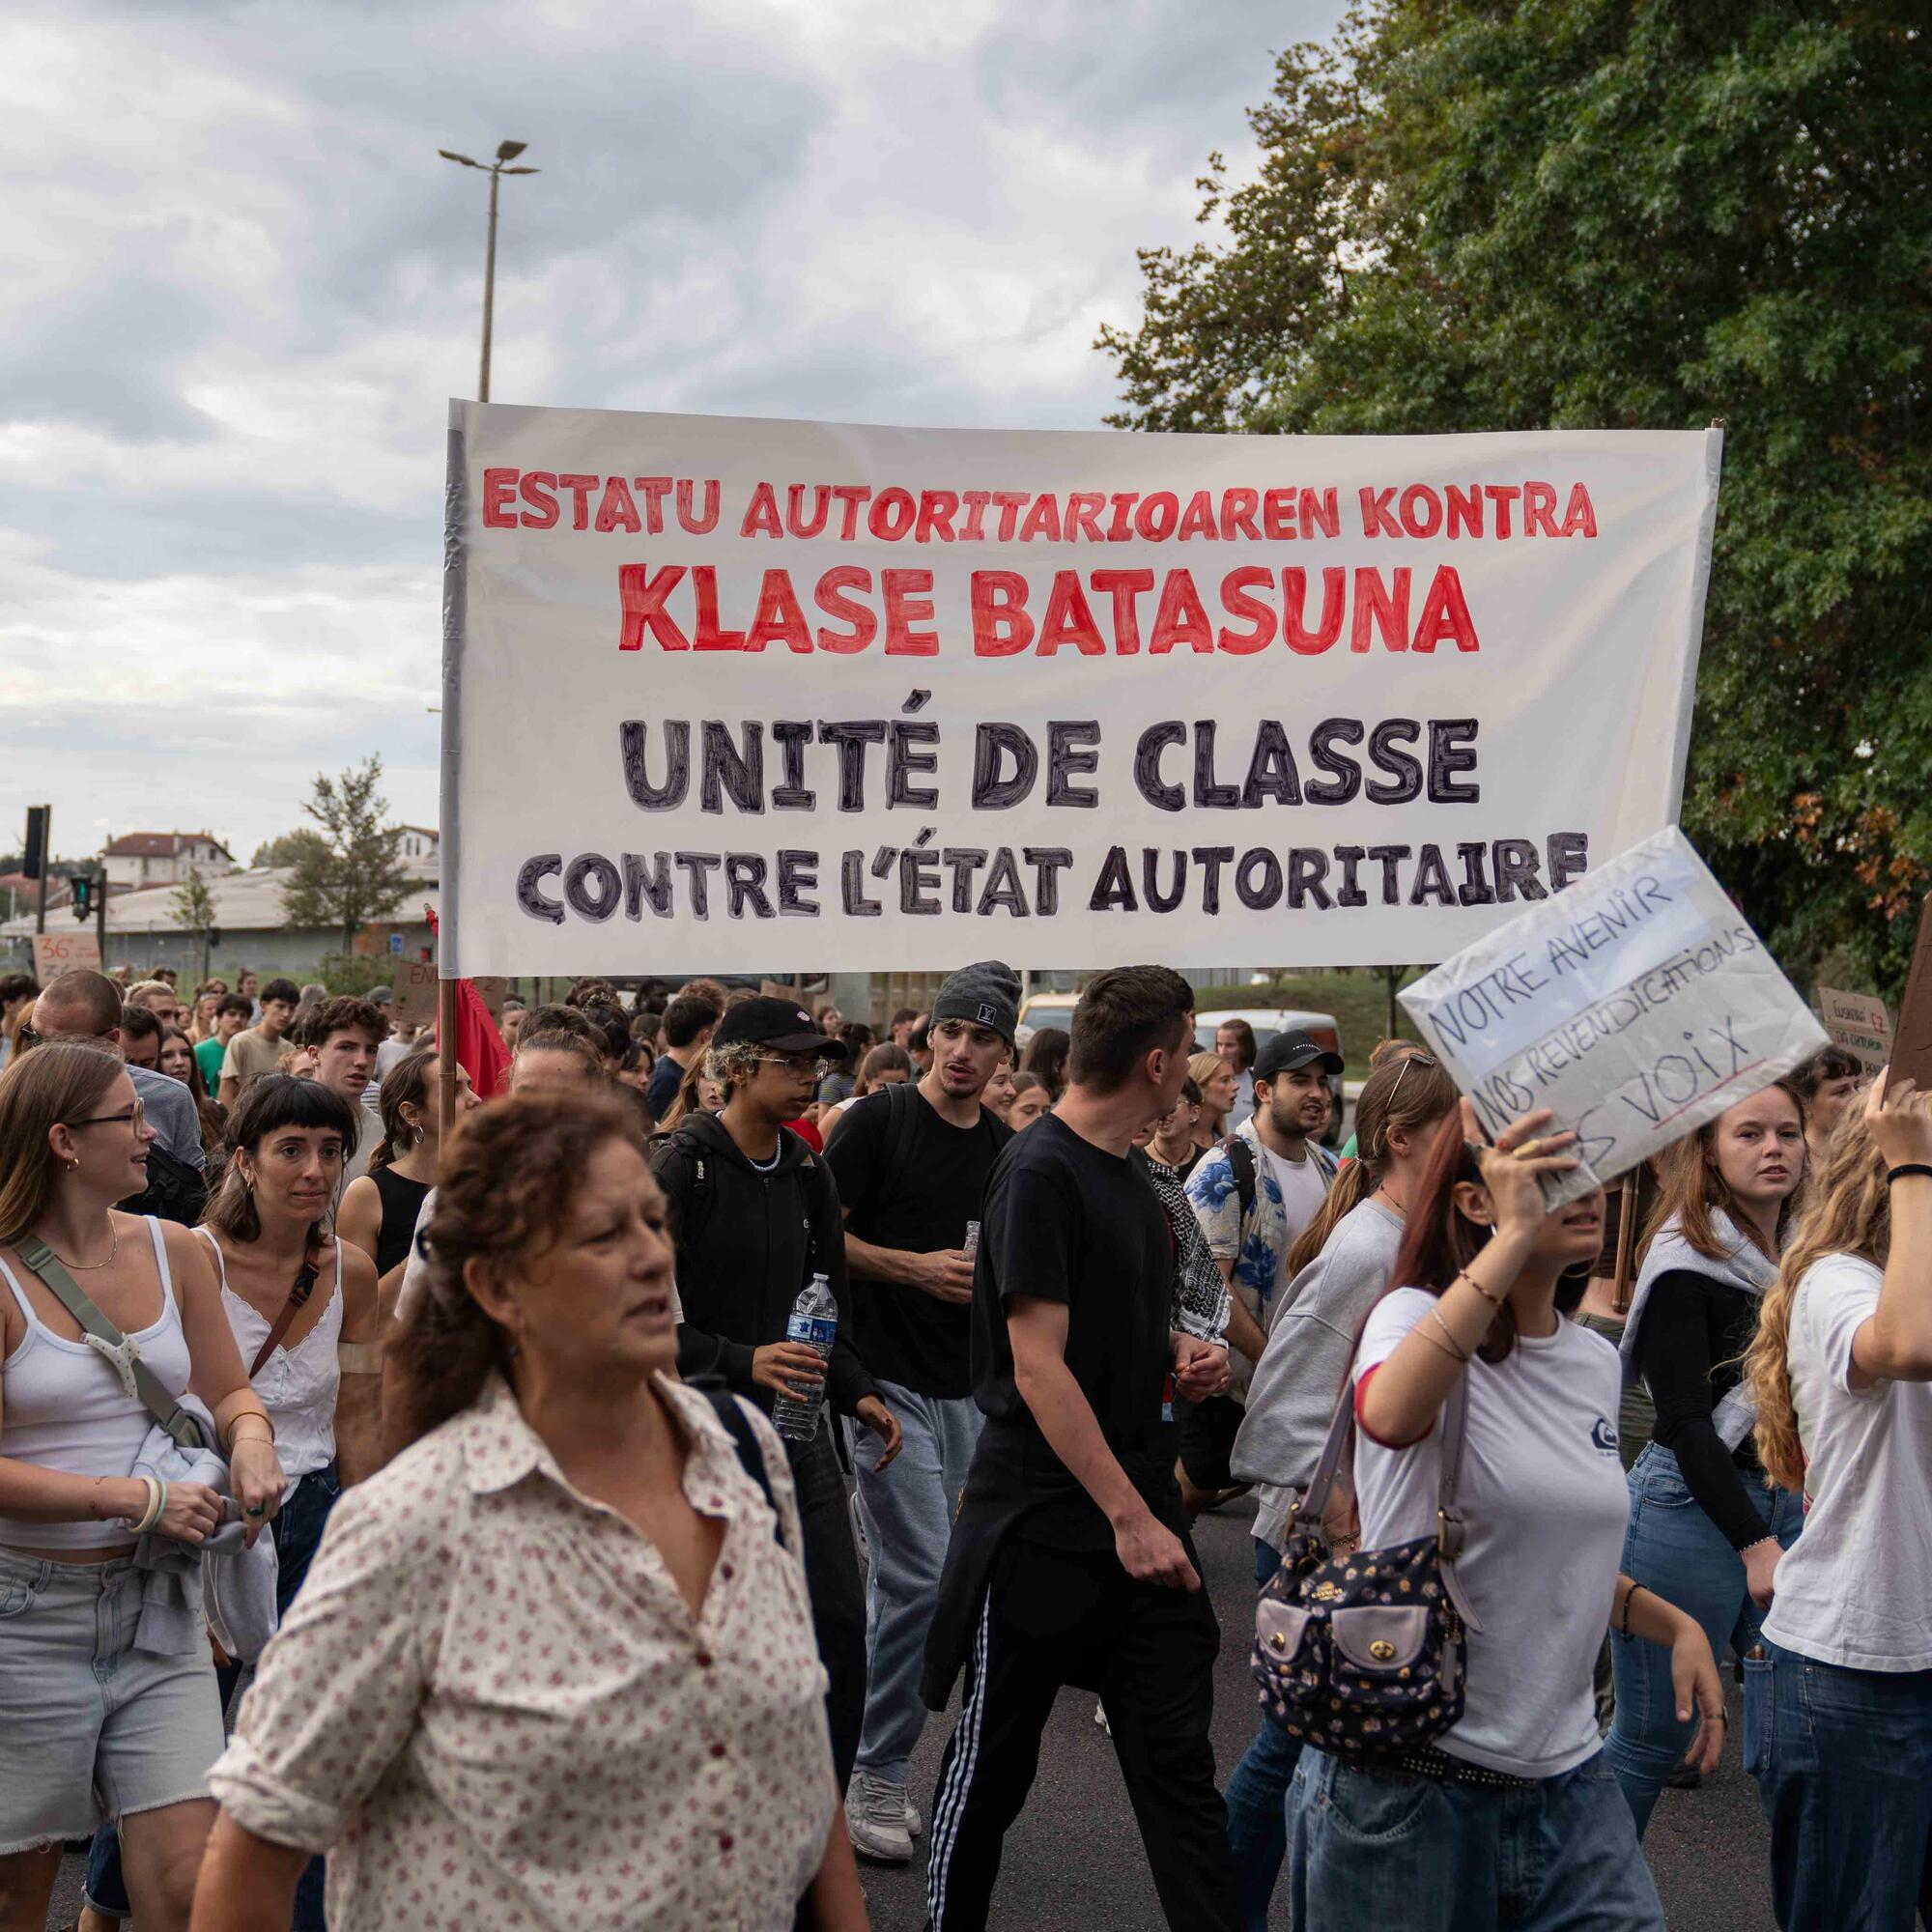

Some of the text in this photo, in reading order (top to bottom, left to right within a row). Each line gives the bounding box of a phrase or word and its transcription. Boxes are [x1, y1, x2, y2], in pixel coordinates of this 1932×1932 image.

[482, 468, 1598, 544] ESTATU AUTORITARIOAREN KONTRA
[617, 562, 1480, 658] KLASE BATASUNA
[619, 688, 1480, 815] UNITÉ DE CLASSE
[516, 827, 1589, 925] CONTRE L'ÉTAT AUTORITAIRE
[1428, 874, 1674, 1057] NOTRE AVENIR
[1471, 925, 1758, 1131] NOS REVENDICATIONS
[1621, 1015, 1749, 1123] VOIX
